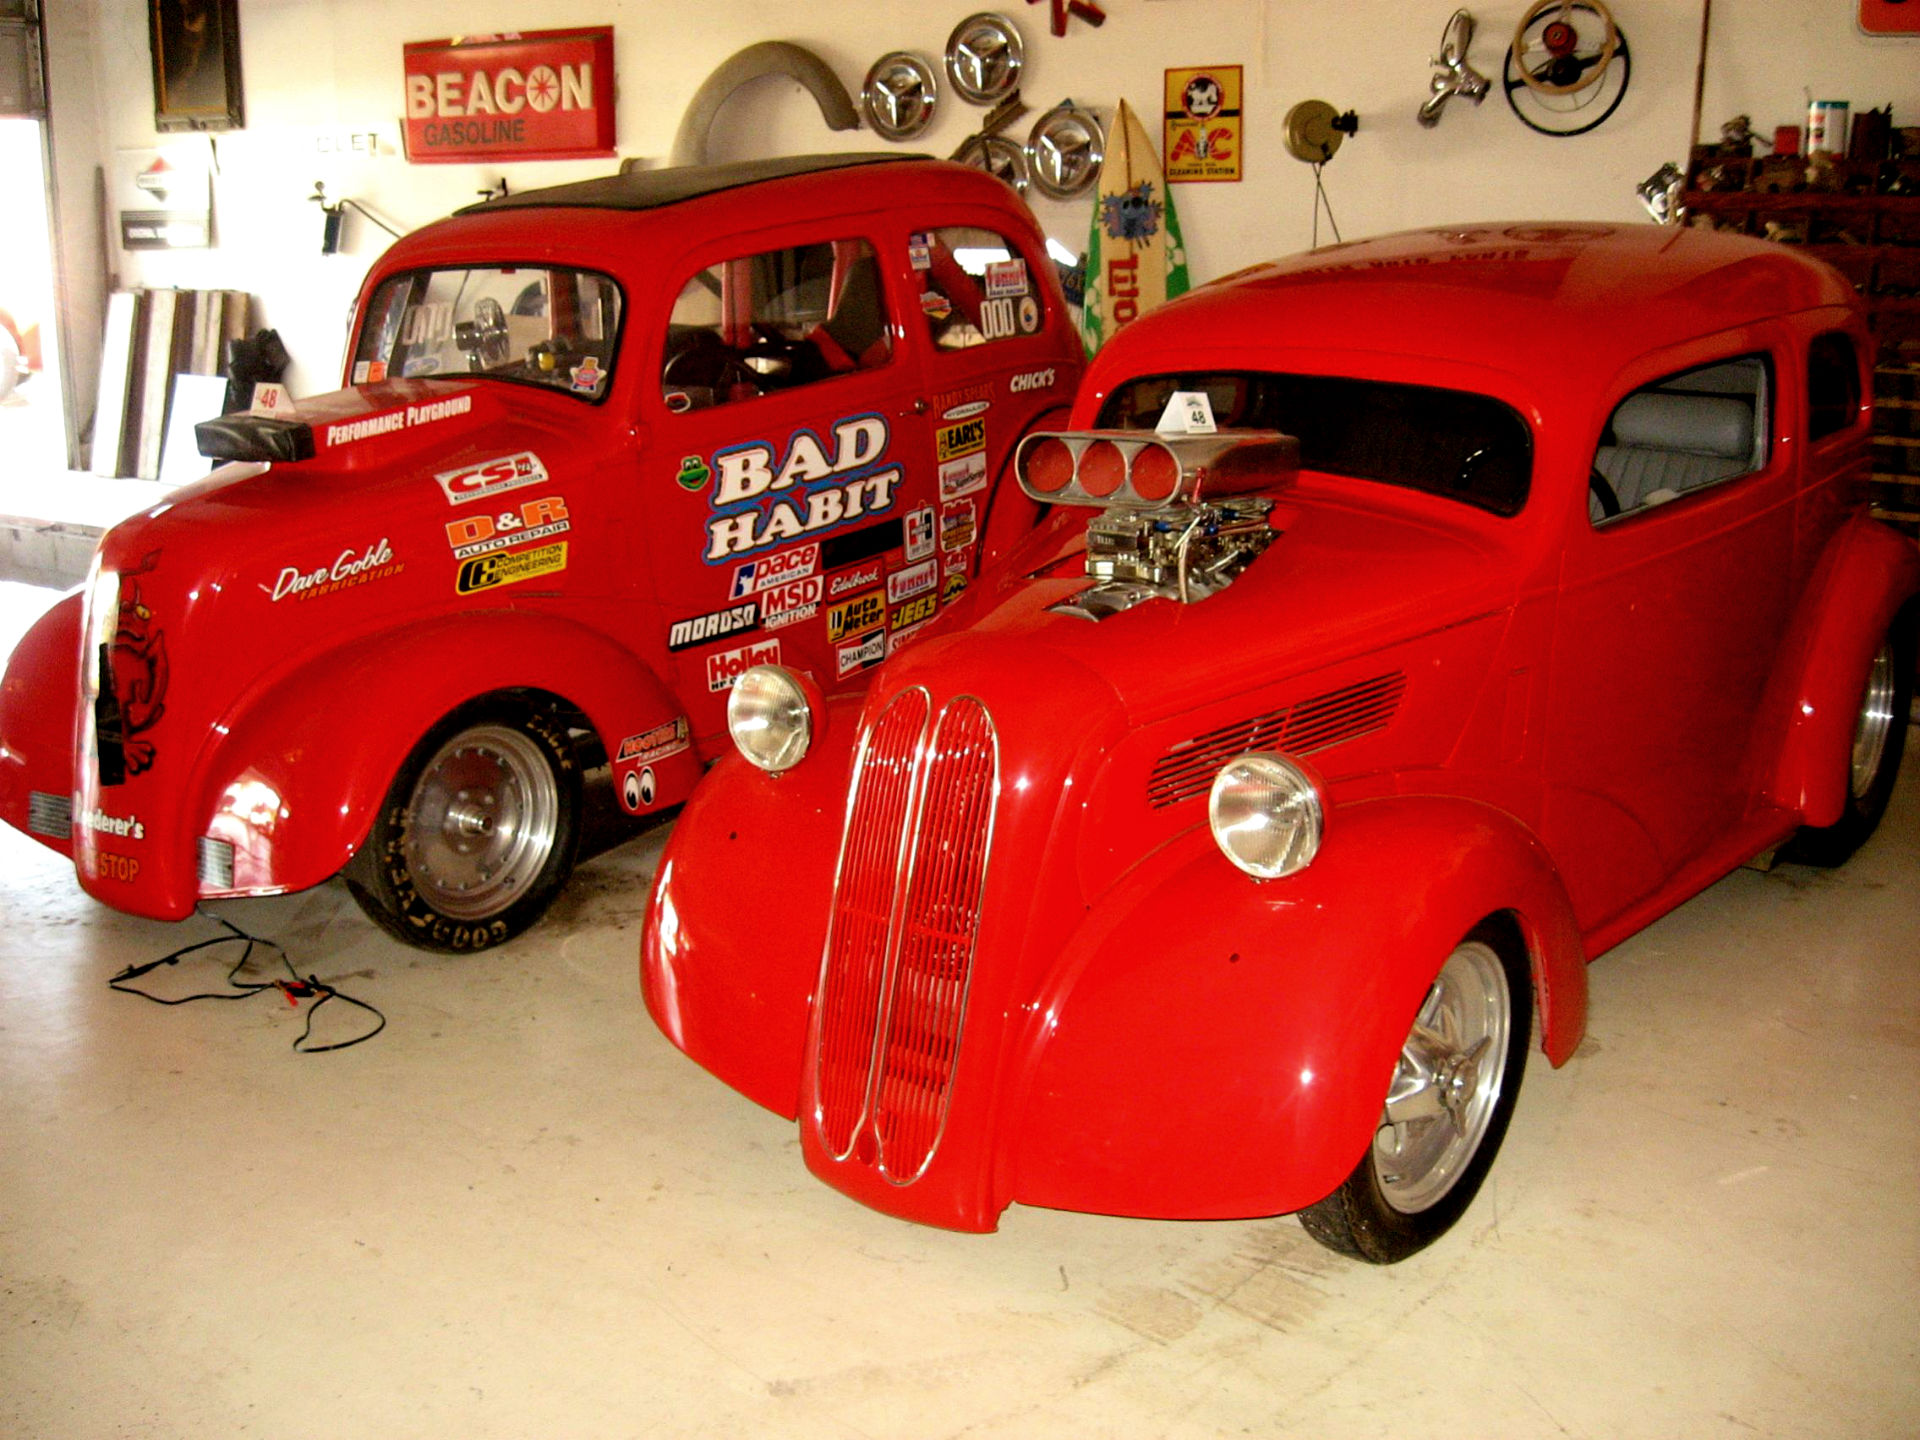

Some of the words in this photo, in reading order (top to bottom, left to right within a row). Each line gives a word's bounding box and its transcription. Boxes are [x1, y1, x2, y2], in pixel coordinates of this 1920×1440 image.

[408, 62, 594, 119] BEACON
[423, 119, 526, 147] GASOLINE
[1171, 127, 1233, 162] AC
[1207, 167, 1235, 175] STATION
[1010, 367, 1055, 393] CHICK'S
[261, 388, 278, 409] 48
[326, 411, 404, 447] PERFORMANCE
[406, 395, 471, 427] PLAYGROUND
[1192, 410, 1206, 425] 48
[947, 419, 984, 449] EARL'S
[714, 417, 887, 506] BAD
[445, 496, 569, 549] D&R
[707, 469, 900, 560] HABIT
[458, 537, 507, 559] AUTO
[509, 522, 567, 546] REPAIR
[497, 544, 563, 567] COMPETITION
[272, 567, 329, 601] Dave
[330, 537, 392, 581] Goble
[495, 553, 561, 580] ENGINEERING
[752, 545, 816, 592] pace
[760, 567, 810, 588] AMERICAN
[830, 566, 878, 595] Edelbrock
[299, 563, 404, 601] FABRICATION
[765, 580, 820, 617] MSD
[845, 597, 878, 620] Auto
[669, 603, 757, 648] MOROSO
[765, 603, 817, 629] IGNITION
[844, 608, 884, 632] Meter
[709, 645, 778, 683] Holley
[840, 641, 883, 668] CHAMPION
[100, 852, 139, 882] STOP
